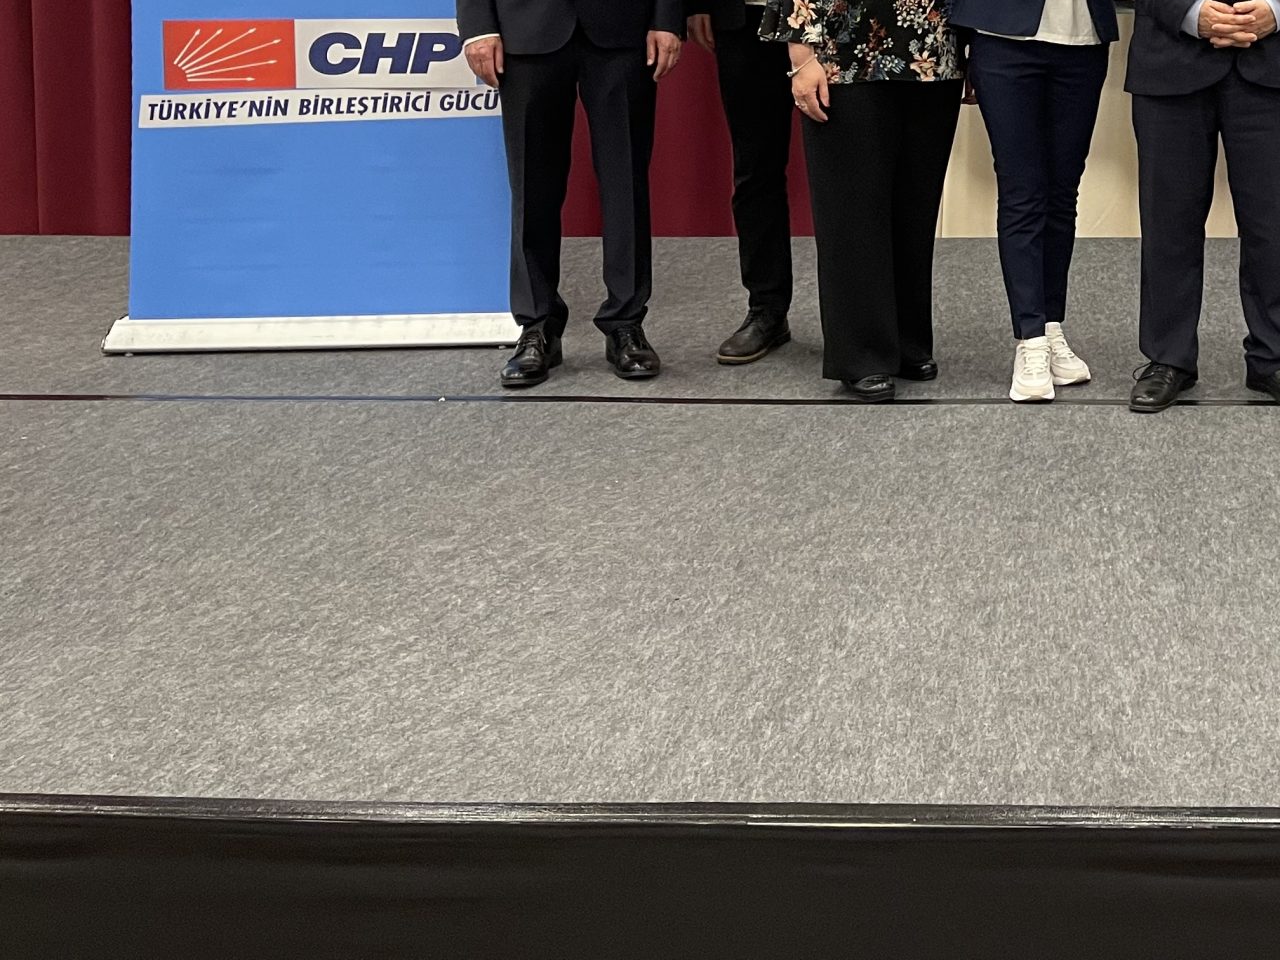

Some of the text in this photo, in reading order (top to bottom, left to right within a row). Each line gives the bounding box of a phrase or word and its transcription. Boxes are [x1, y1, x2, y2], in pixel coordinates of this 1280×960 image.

[308, 32, 464, 75] CHP
[148, 89, 499, 121] TÜRKİYE'NİN BİRLEŞTİRİCİ GÜCÜ
